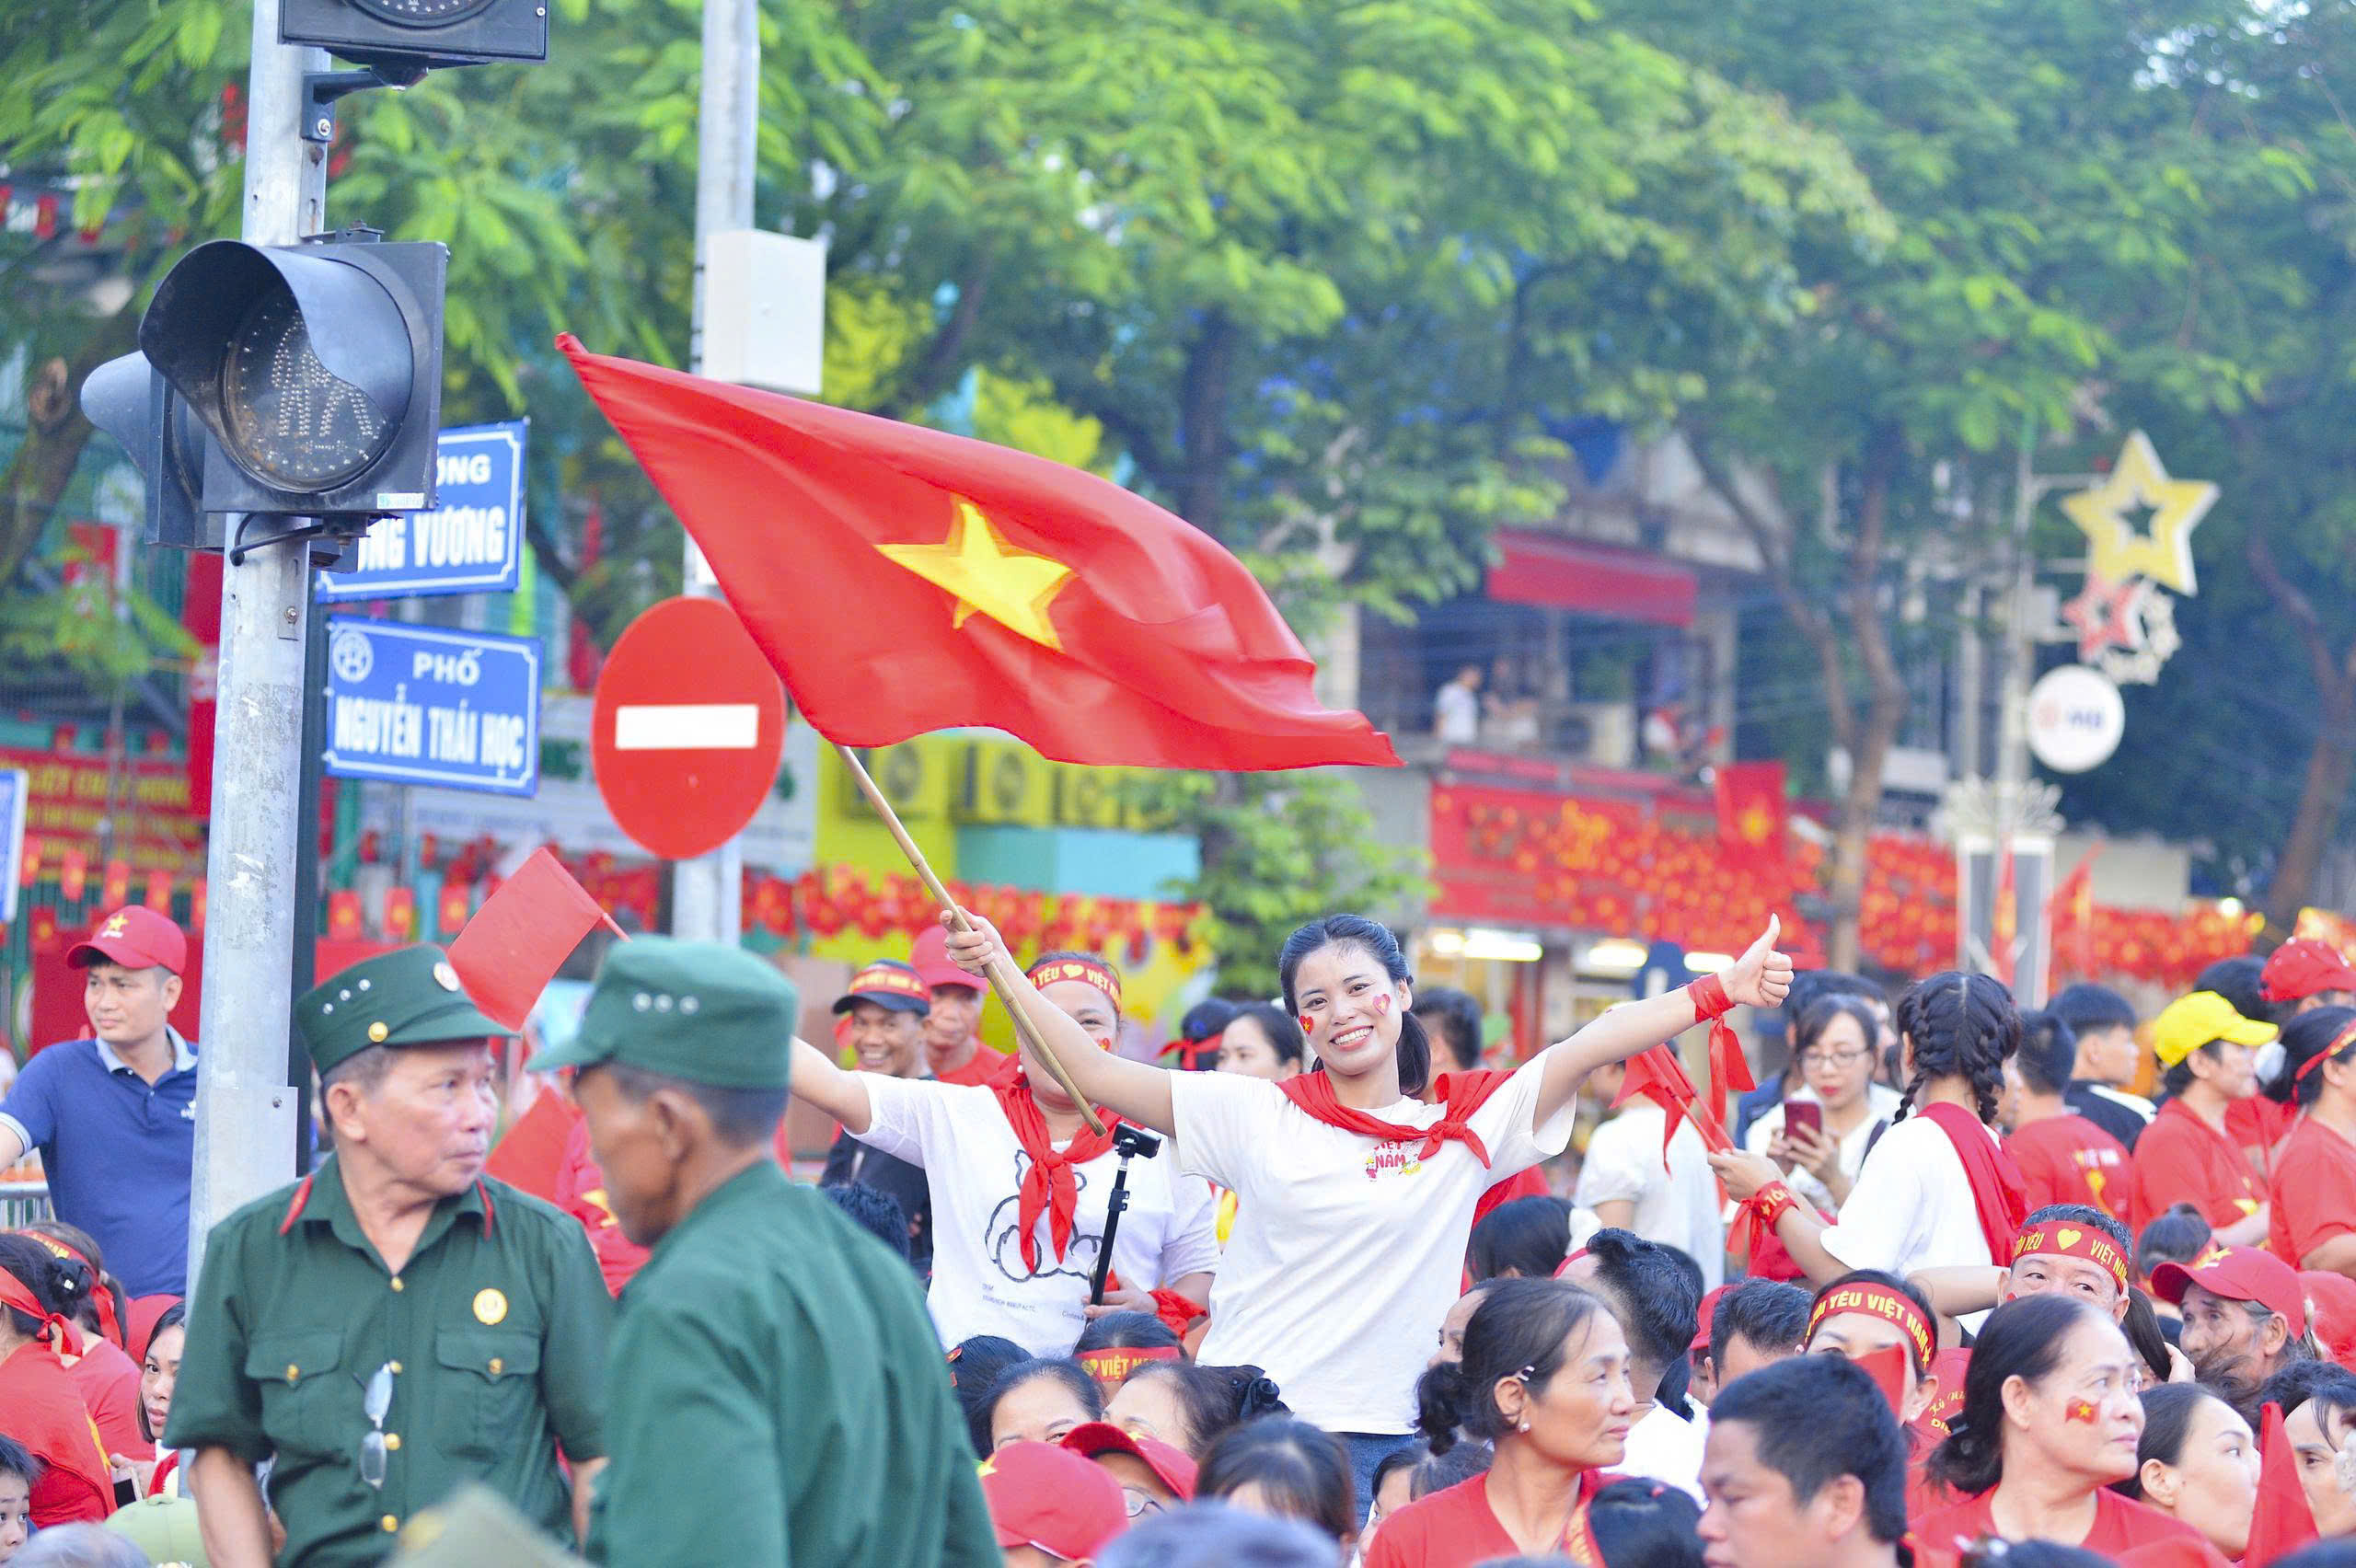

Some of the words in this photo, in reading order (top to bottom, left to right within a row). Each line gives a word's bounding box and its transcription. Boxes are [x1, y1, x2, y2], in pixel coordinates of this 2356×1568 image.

[412, 505, 506, 567] VƯƠNG
[412, 647, 482, 686] PHỐ
[333, 683, 423, 758] NGUYỄN
[427, 698, 479, 764] THÁI
[479, 712, 525, 779] HỌC
[1036, 966, 1060, 986] YÊU
[1375, 1154, 1406, 1169] NAM
[2090, 1238, 2116, 1266] VIỆT
[1829, 1290, 1863, 1309] YÊU
[1867, 1293, 1906, 1320] VIỆT
[1100, 1355, 1129, 1379] VIỆT
